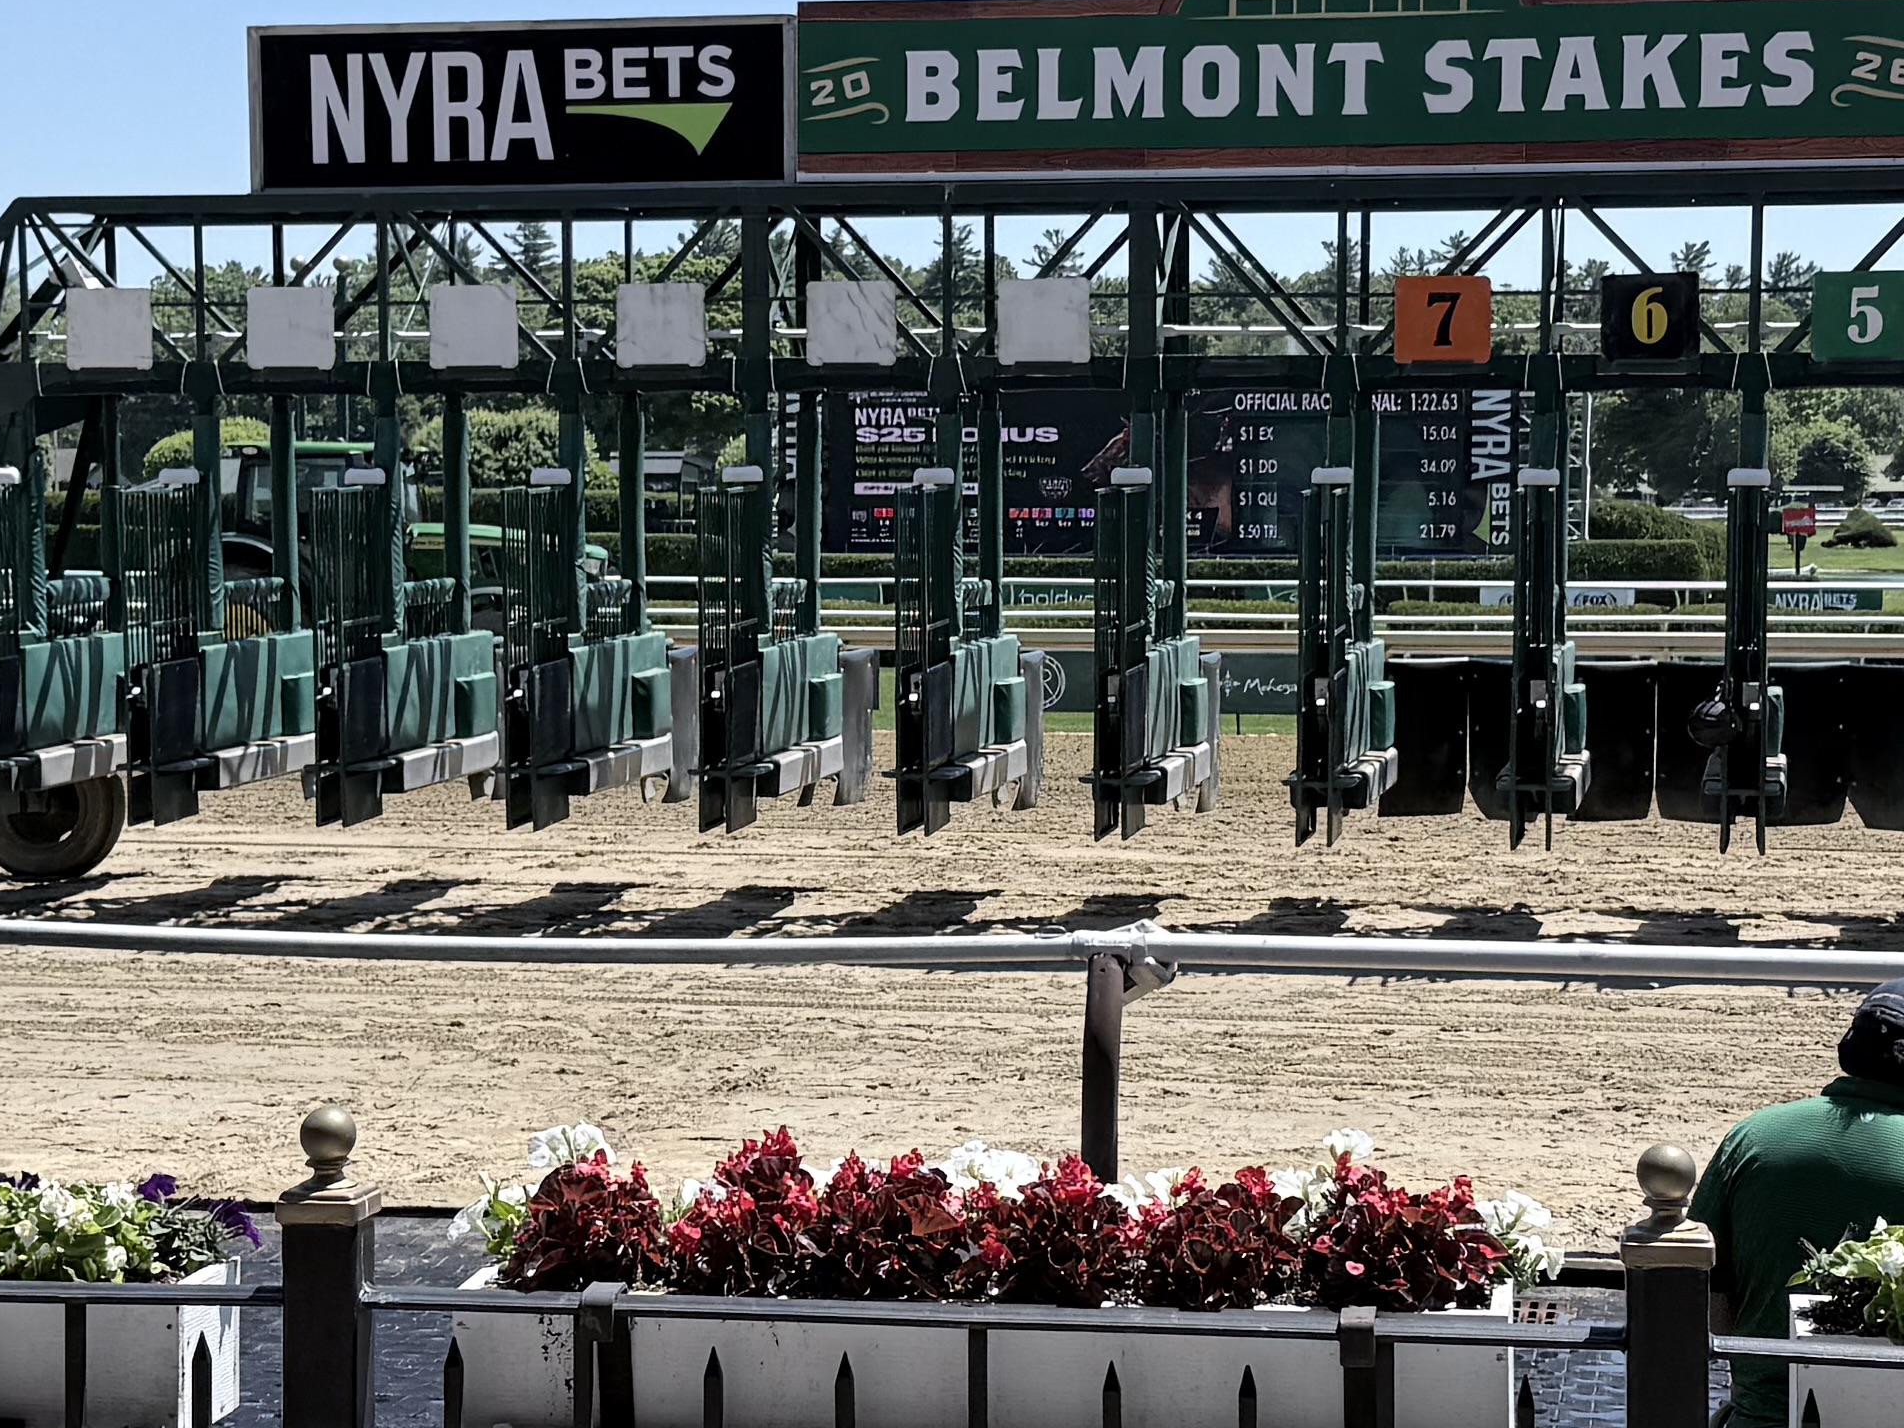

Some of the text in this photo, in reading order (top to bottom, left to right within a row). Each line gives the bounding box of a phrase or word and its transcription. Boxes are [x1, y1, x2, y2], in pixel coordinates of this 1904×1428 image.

[810, 70, 871, 106] 20
[905, 41, 1385, 123] BELMONT
[1422, 30, 1815, 115] STAKES
[309, 44, 736, 164] NYRA BETS
[1426, 291, 1462, 346] 7
[1631, 286, 1668, 344] 6
[1847, 285, 1884, 343] 5
[1234, 392, 1298, 411] OFFICIAL
[1301, 392, 1332, 411] RAC
[1410, 392, 1458, 412] 1:22.63
[855, 407, 906, 426] NYRA
[856, 427, 926, 443] $25
[1239, 425, 1457, 441] $1 EX 15.04
[1239, 458, 1457, 474] $1 DD 34.09
[1471, 389, 1512, 546] NYRA BETS
[1239, 491, 1253, 507] $1
[1428, 491, 1457, 507] 5.16
[1419, 524, 1457, 539] 21.79
[1775, 593, 1821, 610] NYRA
